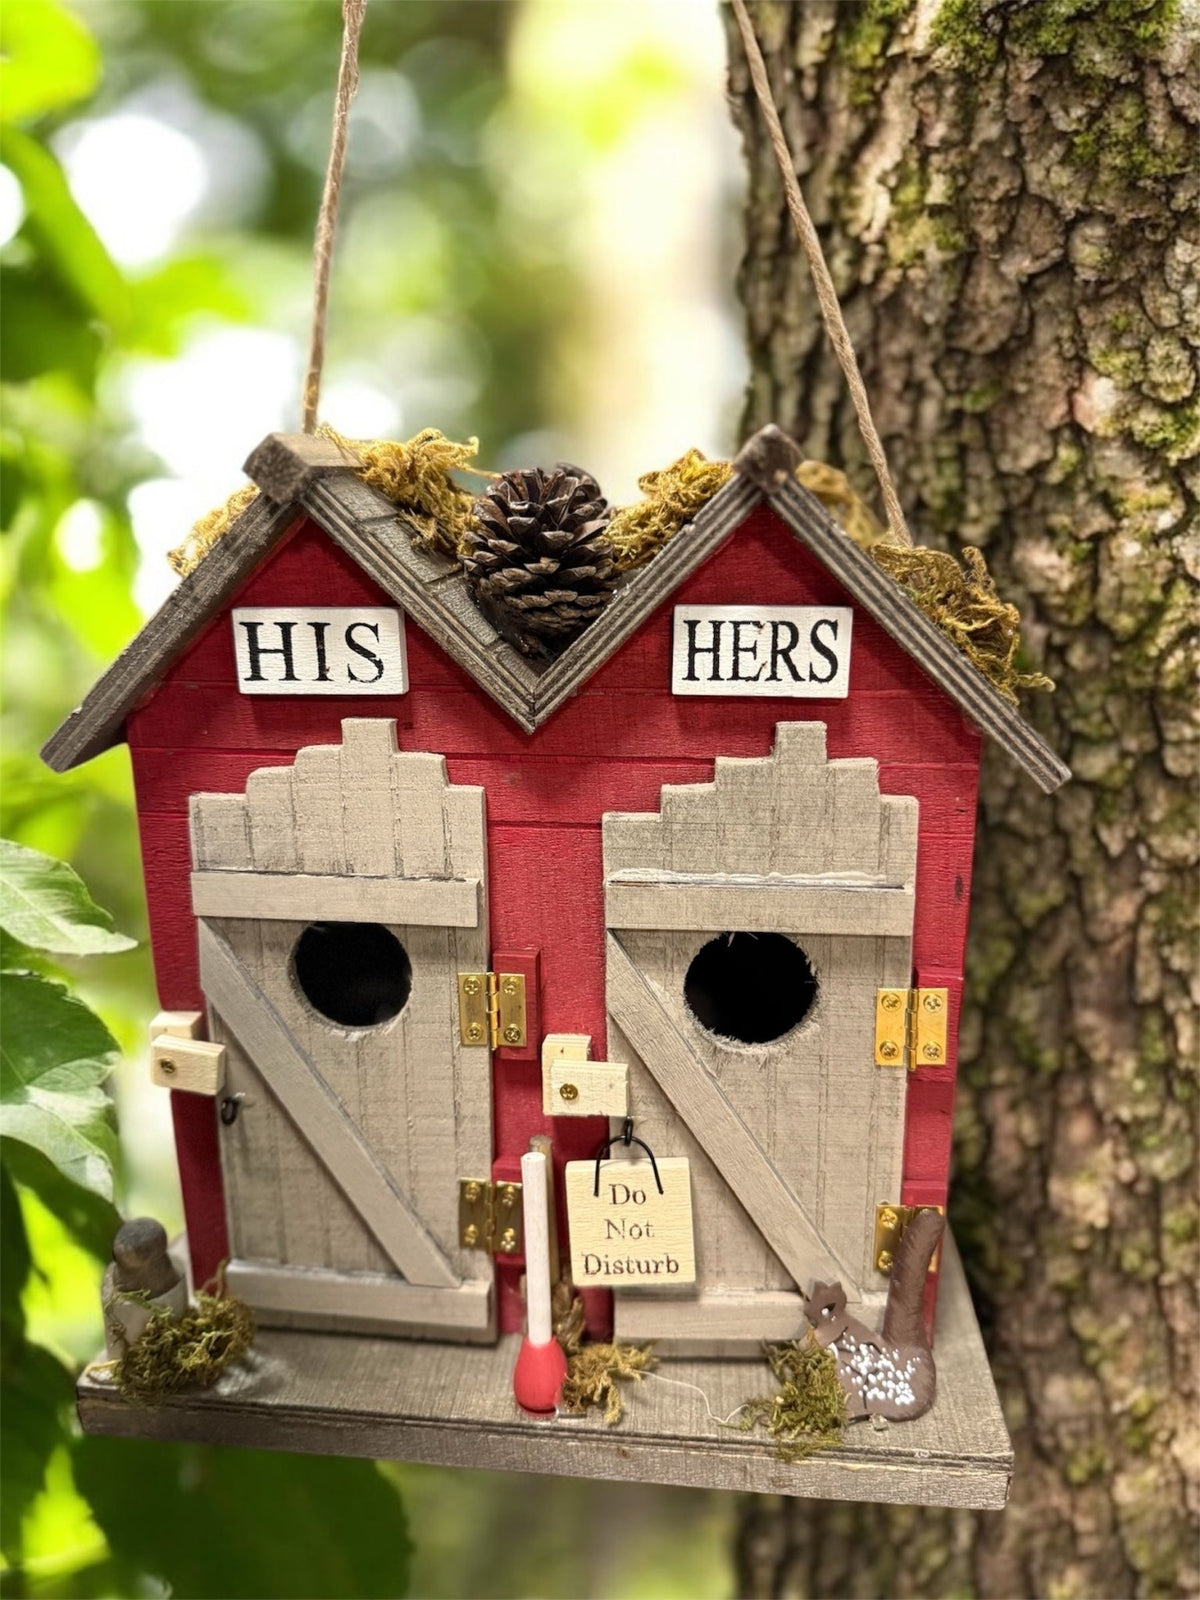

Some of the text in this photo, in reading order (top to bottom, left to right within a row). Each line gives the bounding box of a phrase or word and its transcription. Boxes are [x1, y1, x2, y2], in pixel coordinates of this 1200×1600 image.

[239, 621, 385, 684] HIS
[682, 619, 839, 684] HERS
[608, 1183, 647, 1206] Do
[604, 1218, 656, 1240] Not
[581, 1252, 680, 1276] Disturb
